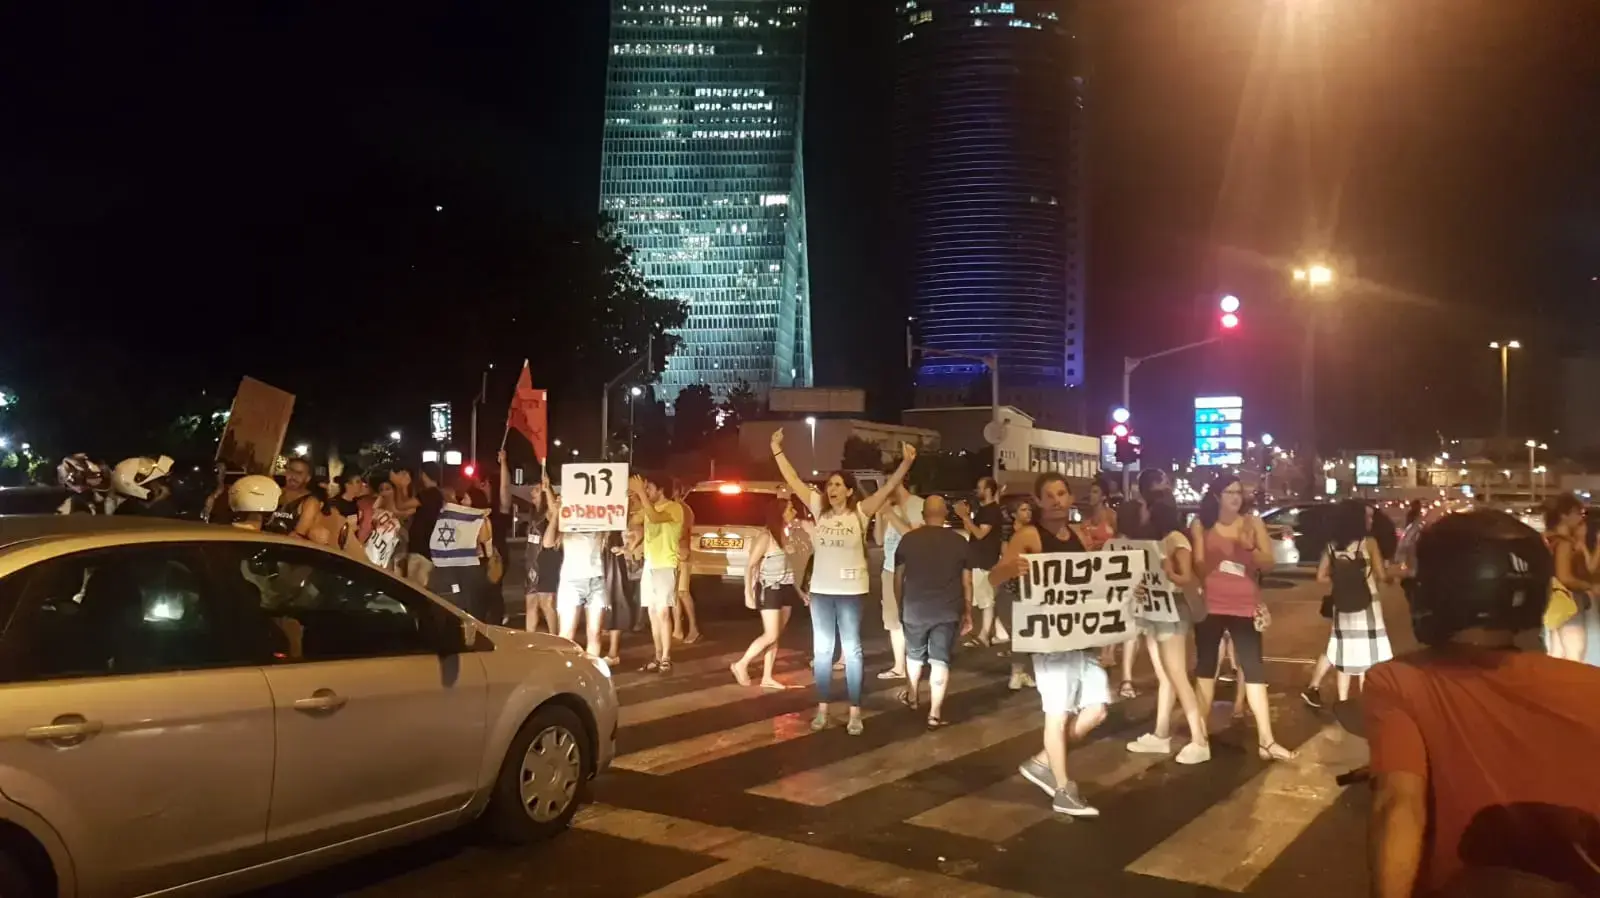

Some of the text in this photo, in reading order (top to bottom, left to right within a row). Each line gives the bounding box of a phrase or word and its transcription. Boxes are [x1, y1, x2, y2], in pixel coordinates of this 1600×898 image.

[573, 468, 613, 496] דור
[1023, 555, 1132, 600] ביטחון
[1040, 586, 1129, 606] זו זכות
[1019, 609, 1126, 639] בסיסית
